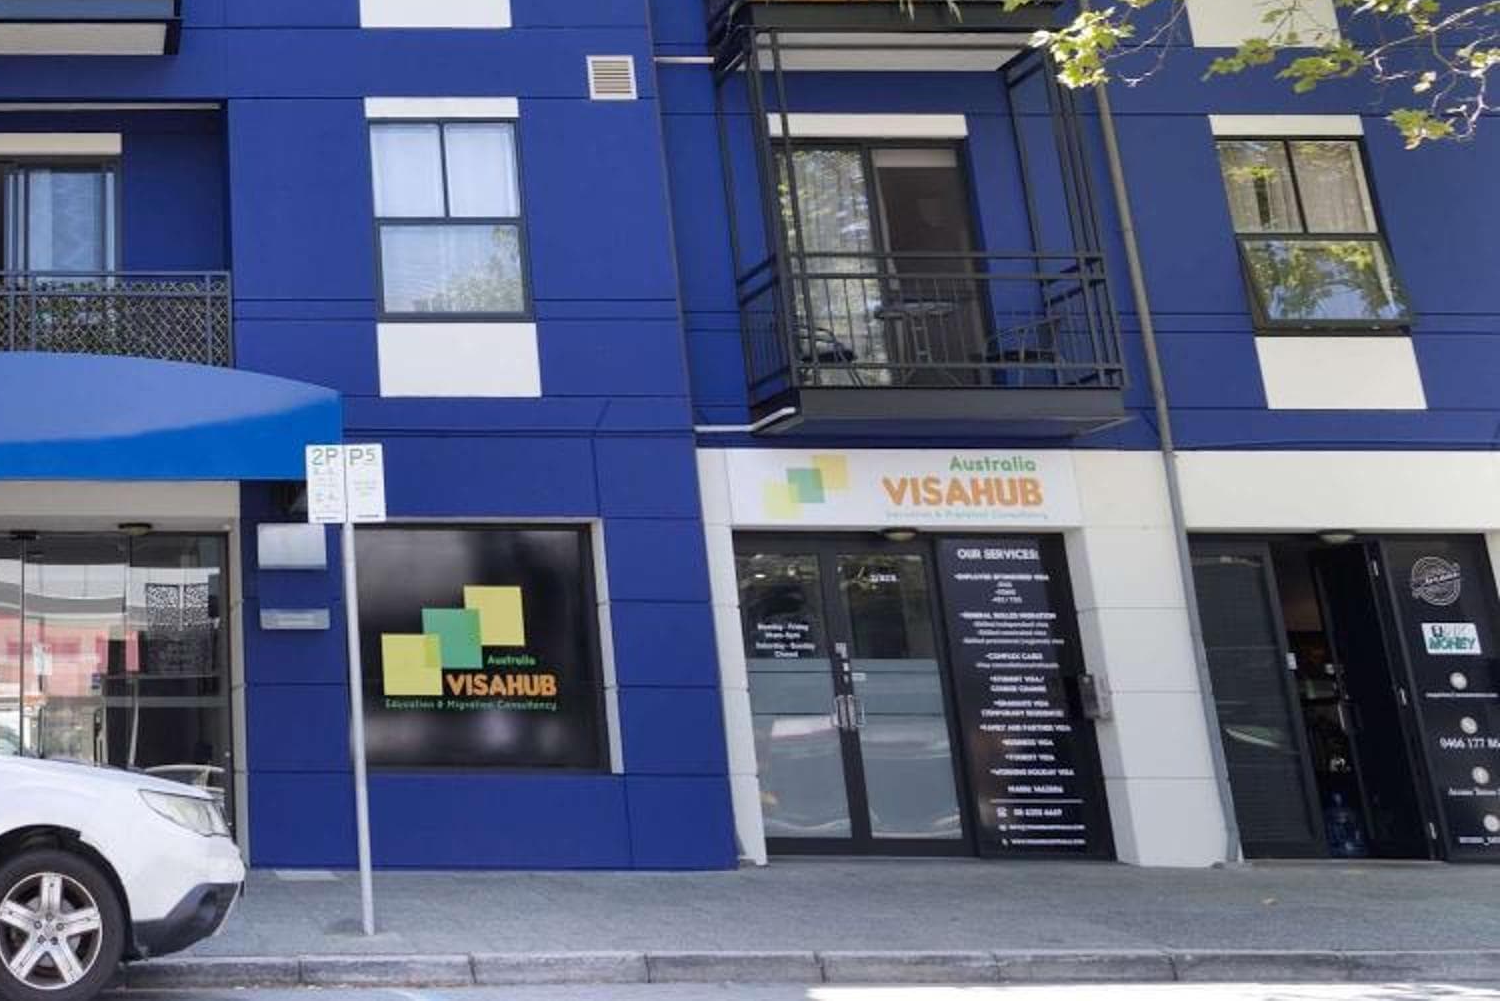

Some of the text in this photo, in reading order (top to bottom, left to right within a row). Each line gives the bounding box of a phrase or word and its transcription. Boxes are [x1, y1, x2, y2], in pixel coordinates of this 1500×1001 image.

[312, 448, 339, 466] 2P
[949, 456, 1036, 472] Australia
[882, 476, 1044, 507] VISAHUB
[957, 549, 982, 560] OUR
[1428, 636, 1476, 650] MONEY
[487, 655, 536, 666] Australia
[446, 674, 557, 696] VISAHUB
